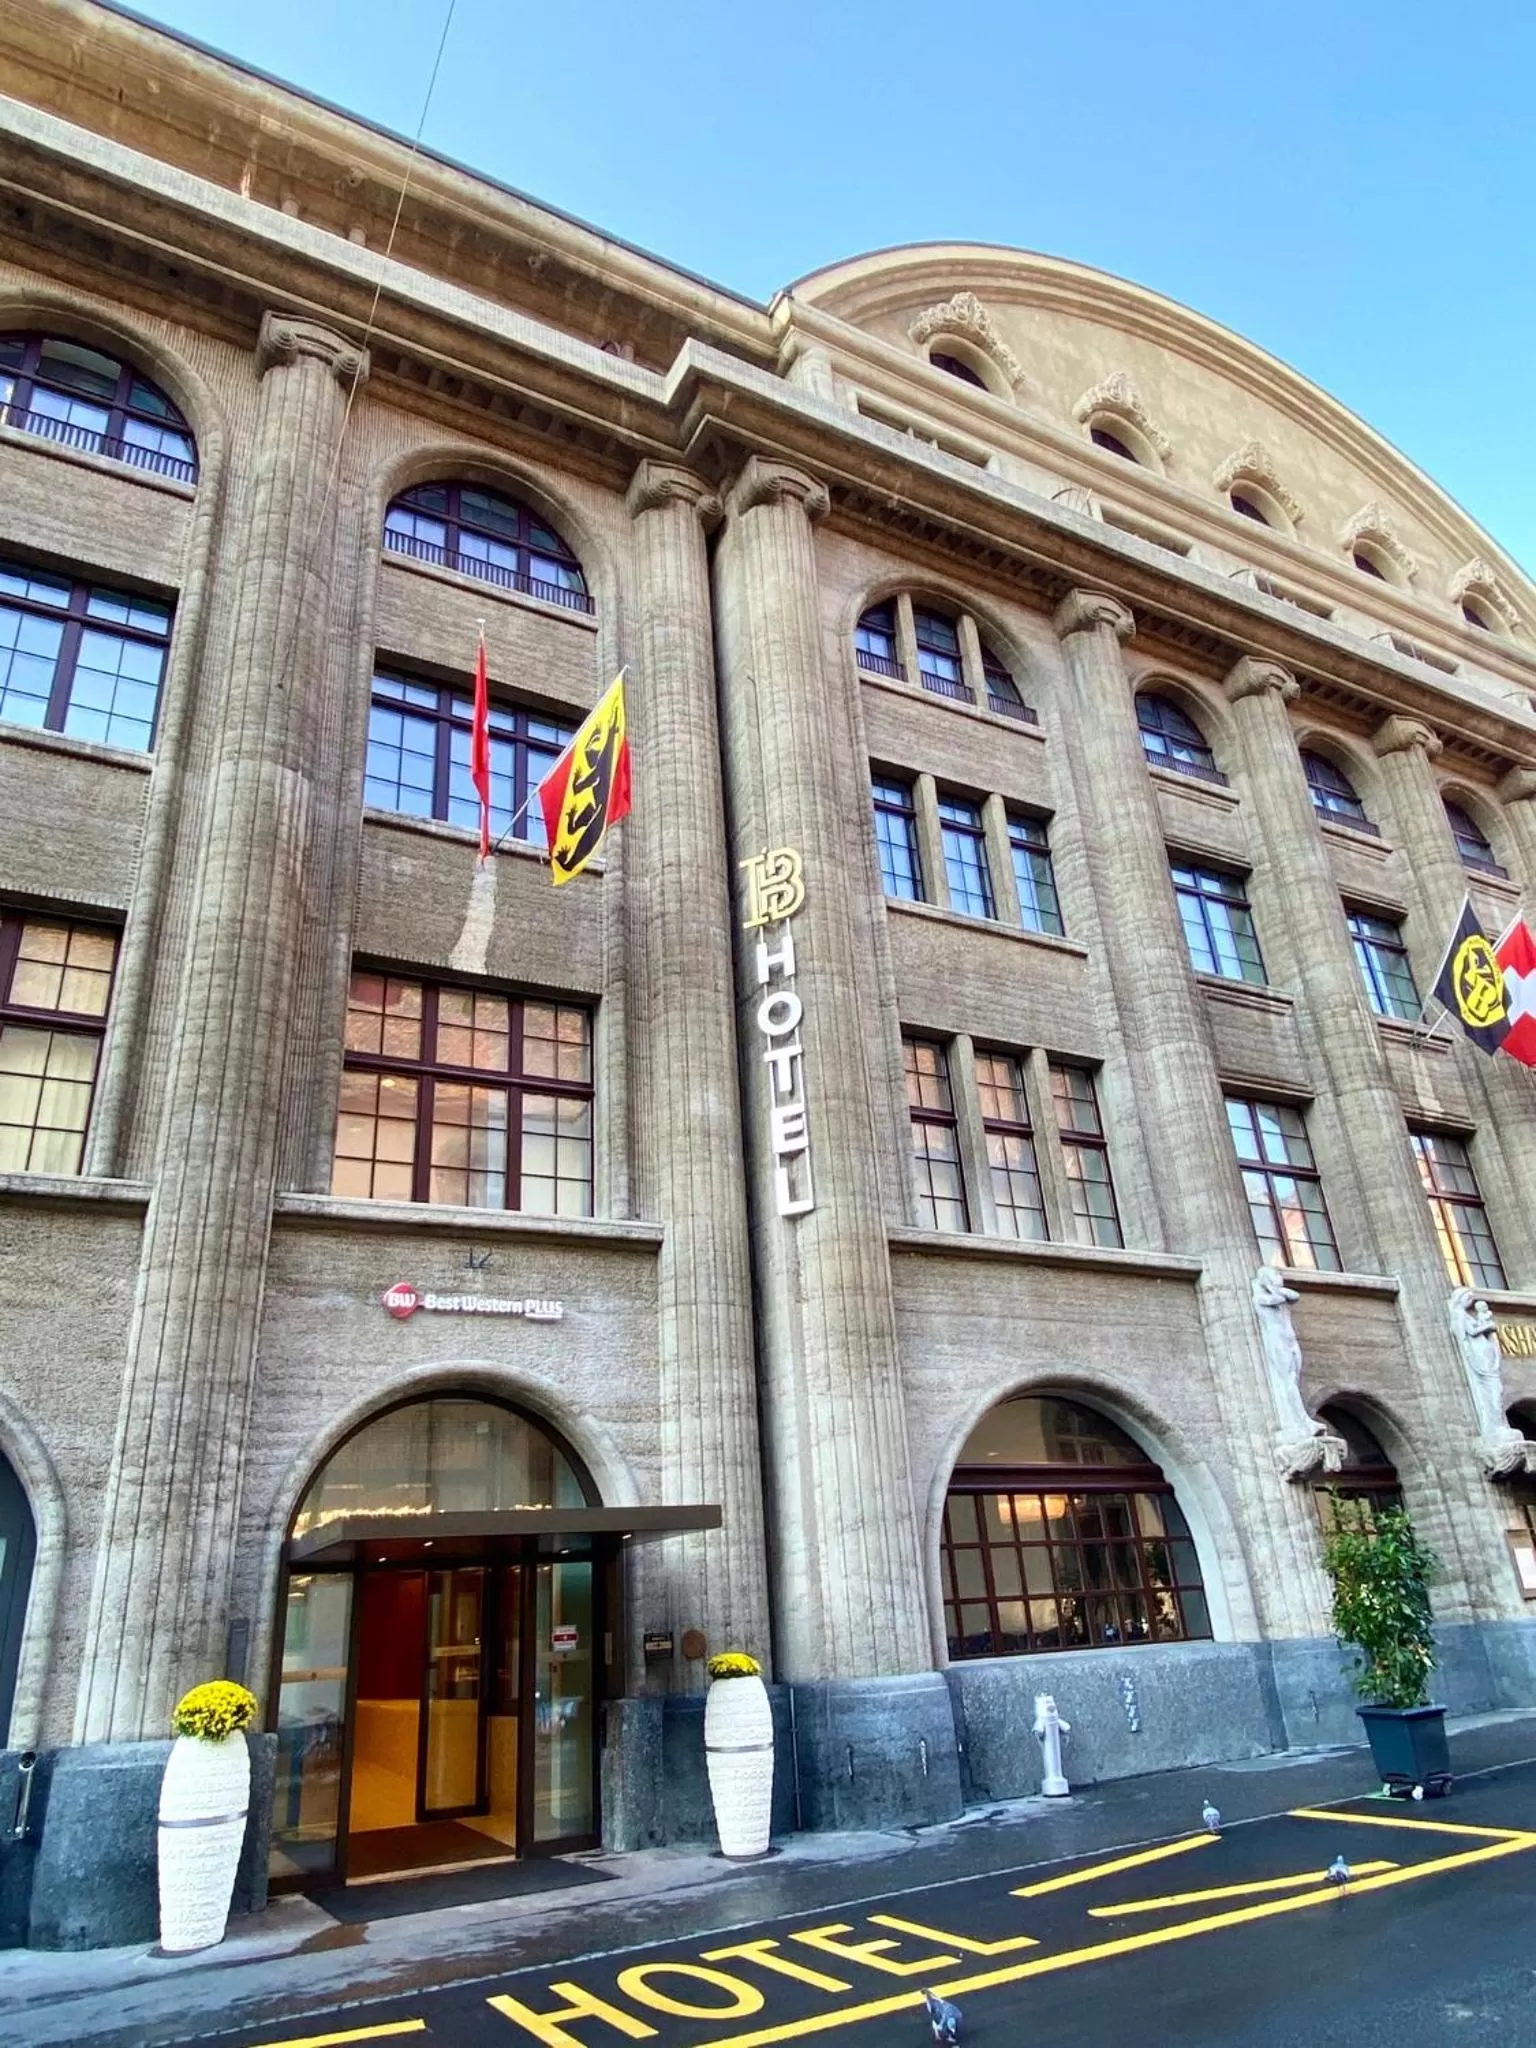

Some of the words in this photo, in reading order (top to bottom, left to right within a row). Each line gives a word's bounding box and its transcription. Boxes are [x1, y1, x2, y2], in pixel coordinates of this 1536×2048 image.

[757, 934, 814, 1216] HOTEL
[388, 1292, 416, 1308] BW
[424, 1294, 461, 1310] Best
[461, 1296, 522, 1313] Western
[525, 1299, 563, 1314] PLUS
[486, 1914, 1041, 2048] HOTEL
